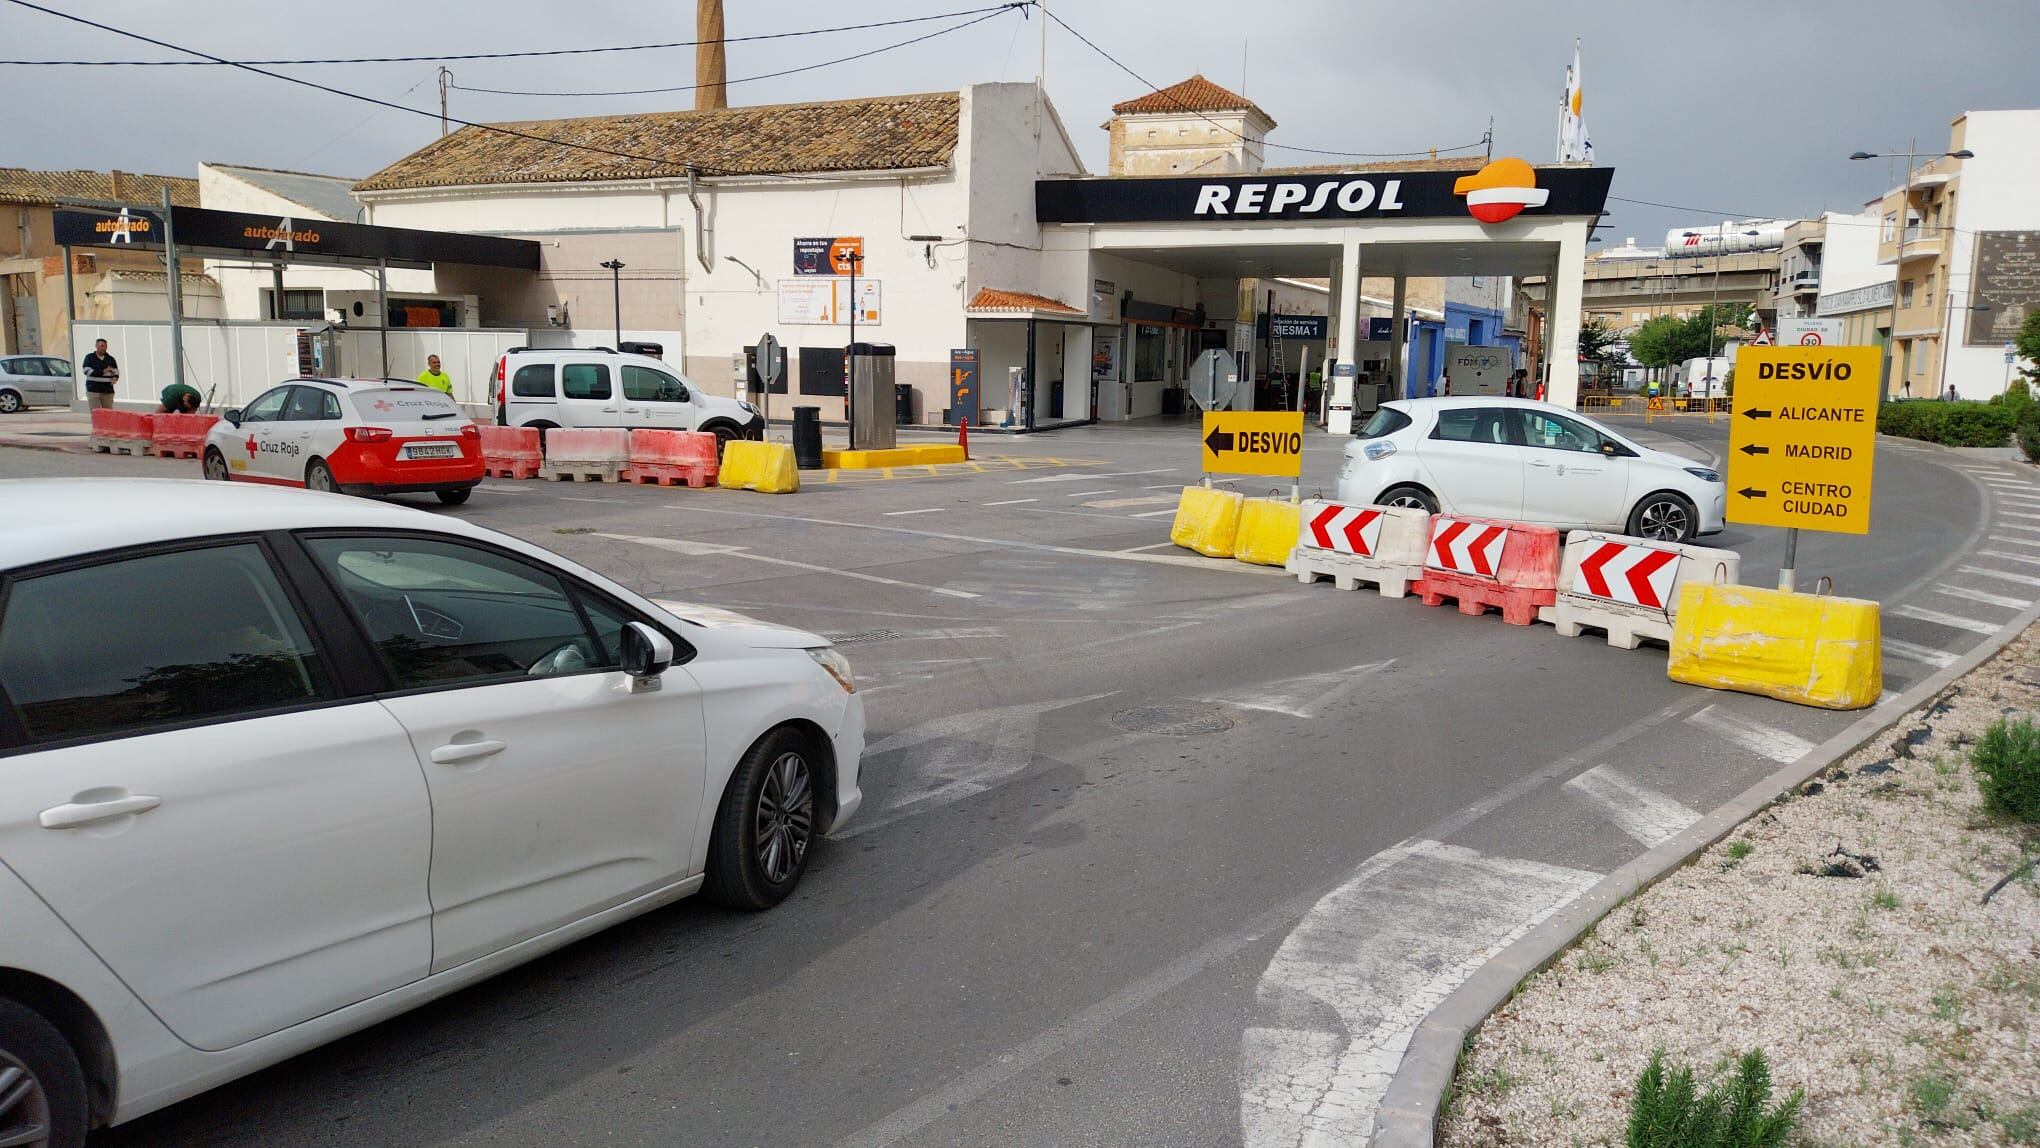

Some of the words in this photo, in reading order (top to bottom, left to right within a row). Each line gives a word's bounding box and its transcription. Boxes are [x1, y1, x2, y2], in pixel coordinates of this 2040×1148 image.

[1193, 179, 1404, 215] REPSOL
[95, 219, 150, 233] autolavado
[243, 226, 320, 244] autolavado
[1804, 338, 1818, 346] 30
[1758, 358, 1852, 381] DESVÍO
[424, 400, 450, 408] Roja
[1778, 406, 1865, 422] ALICANTE
[260, 440, 279, 454] Cruz
[280, 441, 300, 458] Roja
[1238, 431, 1301, 455] DESVIO
[1785, 444, 1853, 460] MADRID
[1781, 481, 1852, 499] CENTRO
[1783, 500, 1848, 517] CIUDAD
